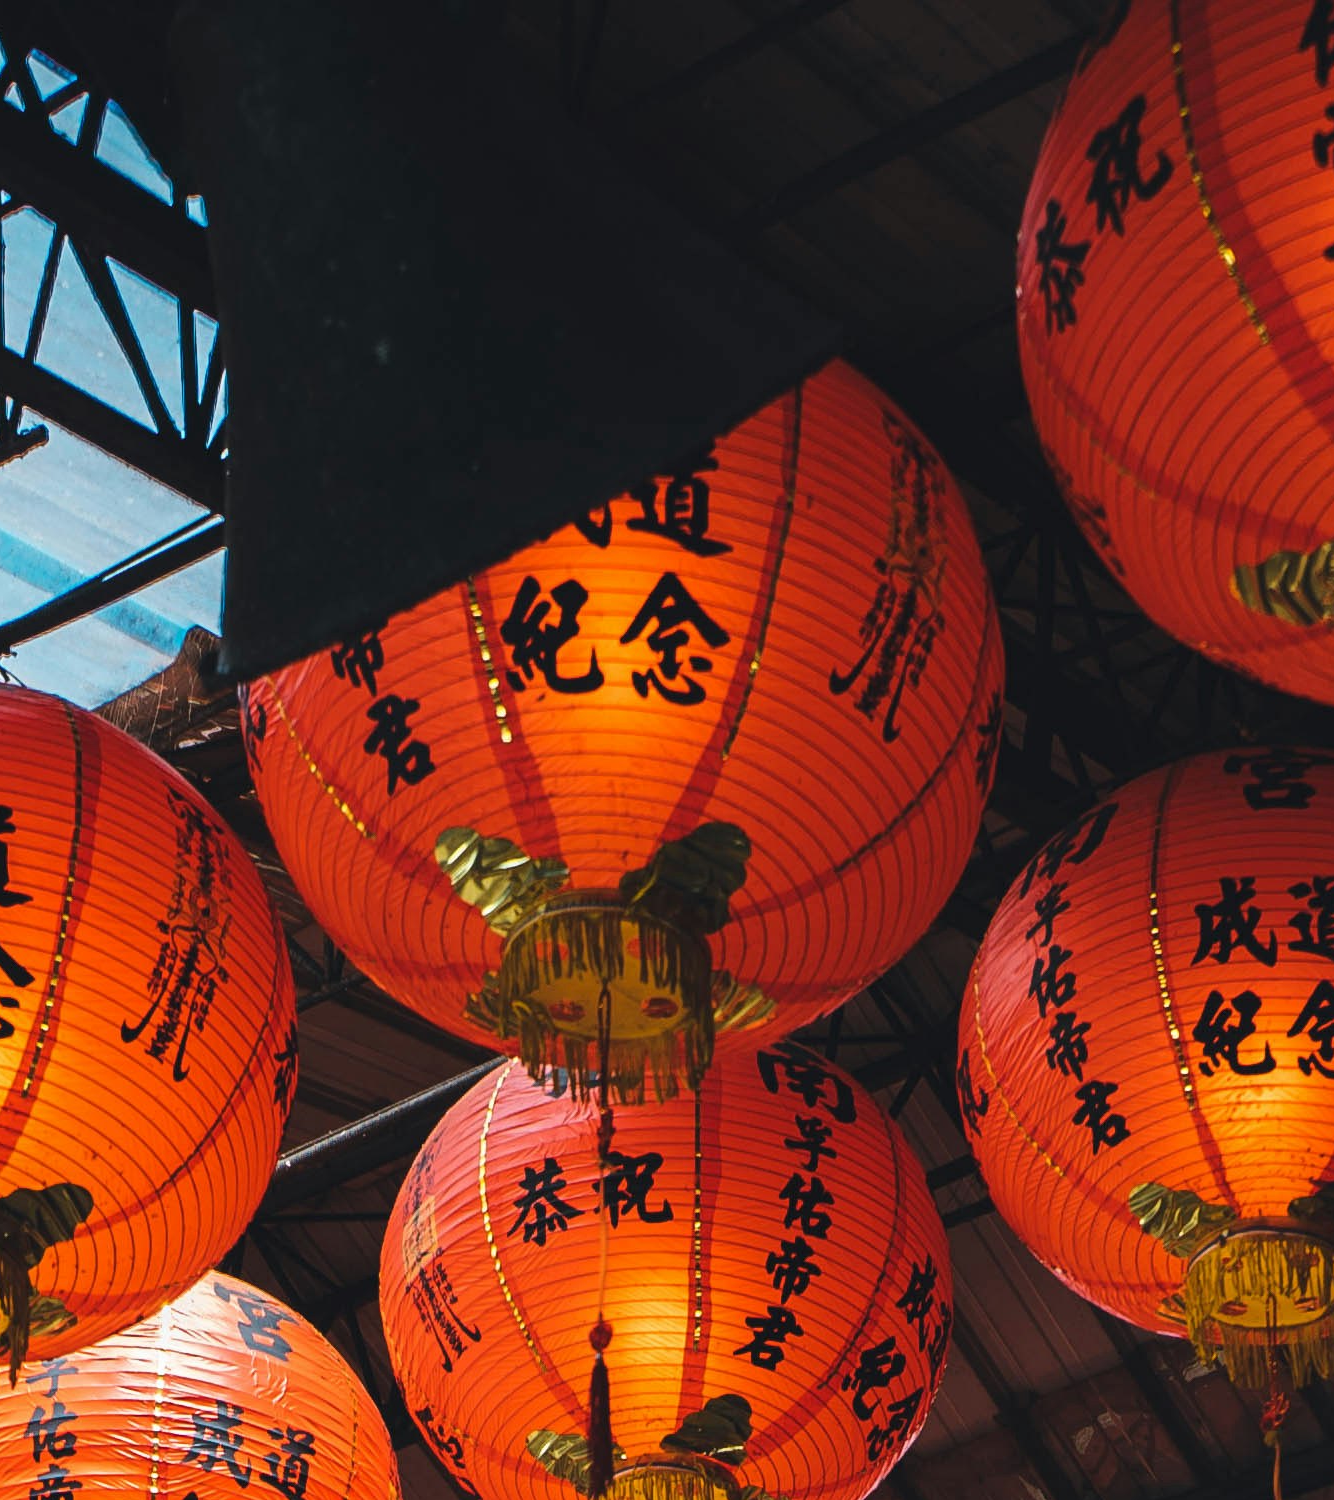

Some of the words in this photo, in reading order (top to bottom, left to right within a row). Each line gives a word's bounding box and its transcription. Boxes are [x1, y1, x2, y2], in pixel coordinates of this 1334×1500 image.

[501, 573, 730, 706] 紀念
[734, 1115, 833, 1373] 孚佑帝君
